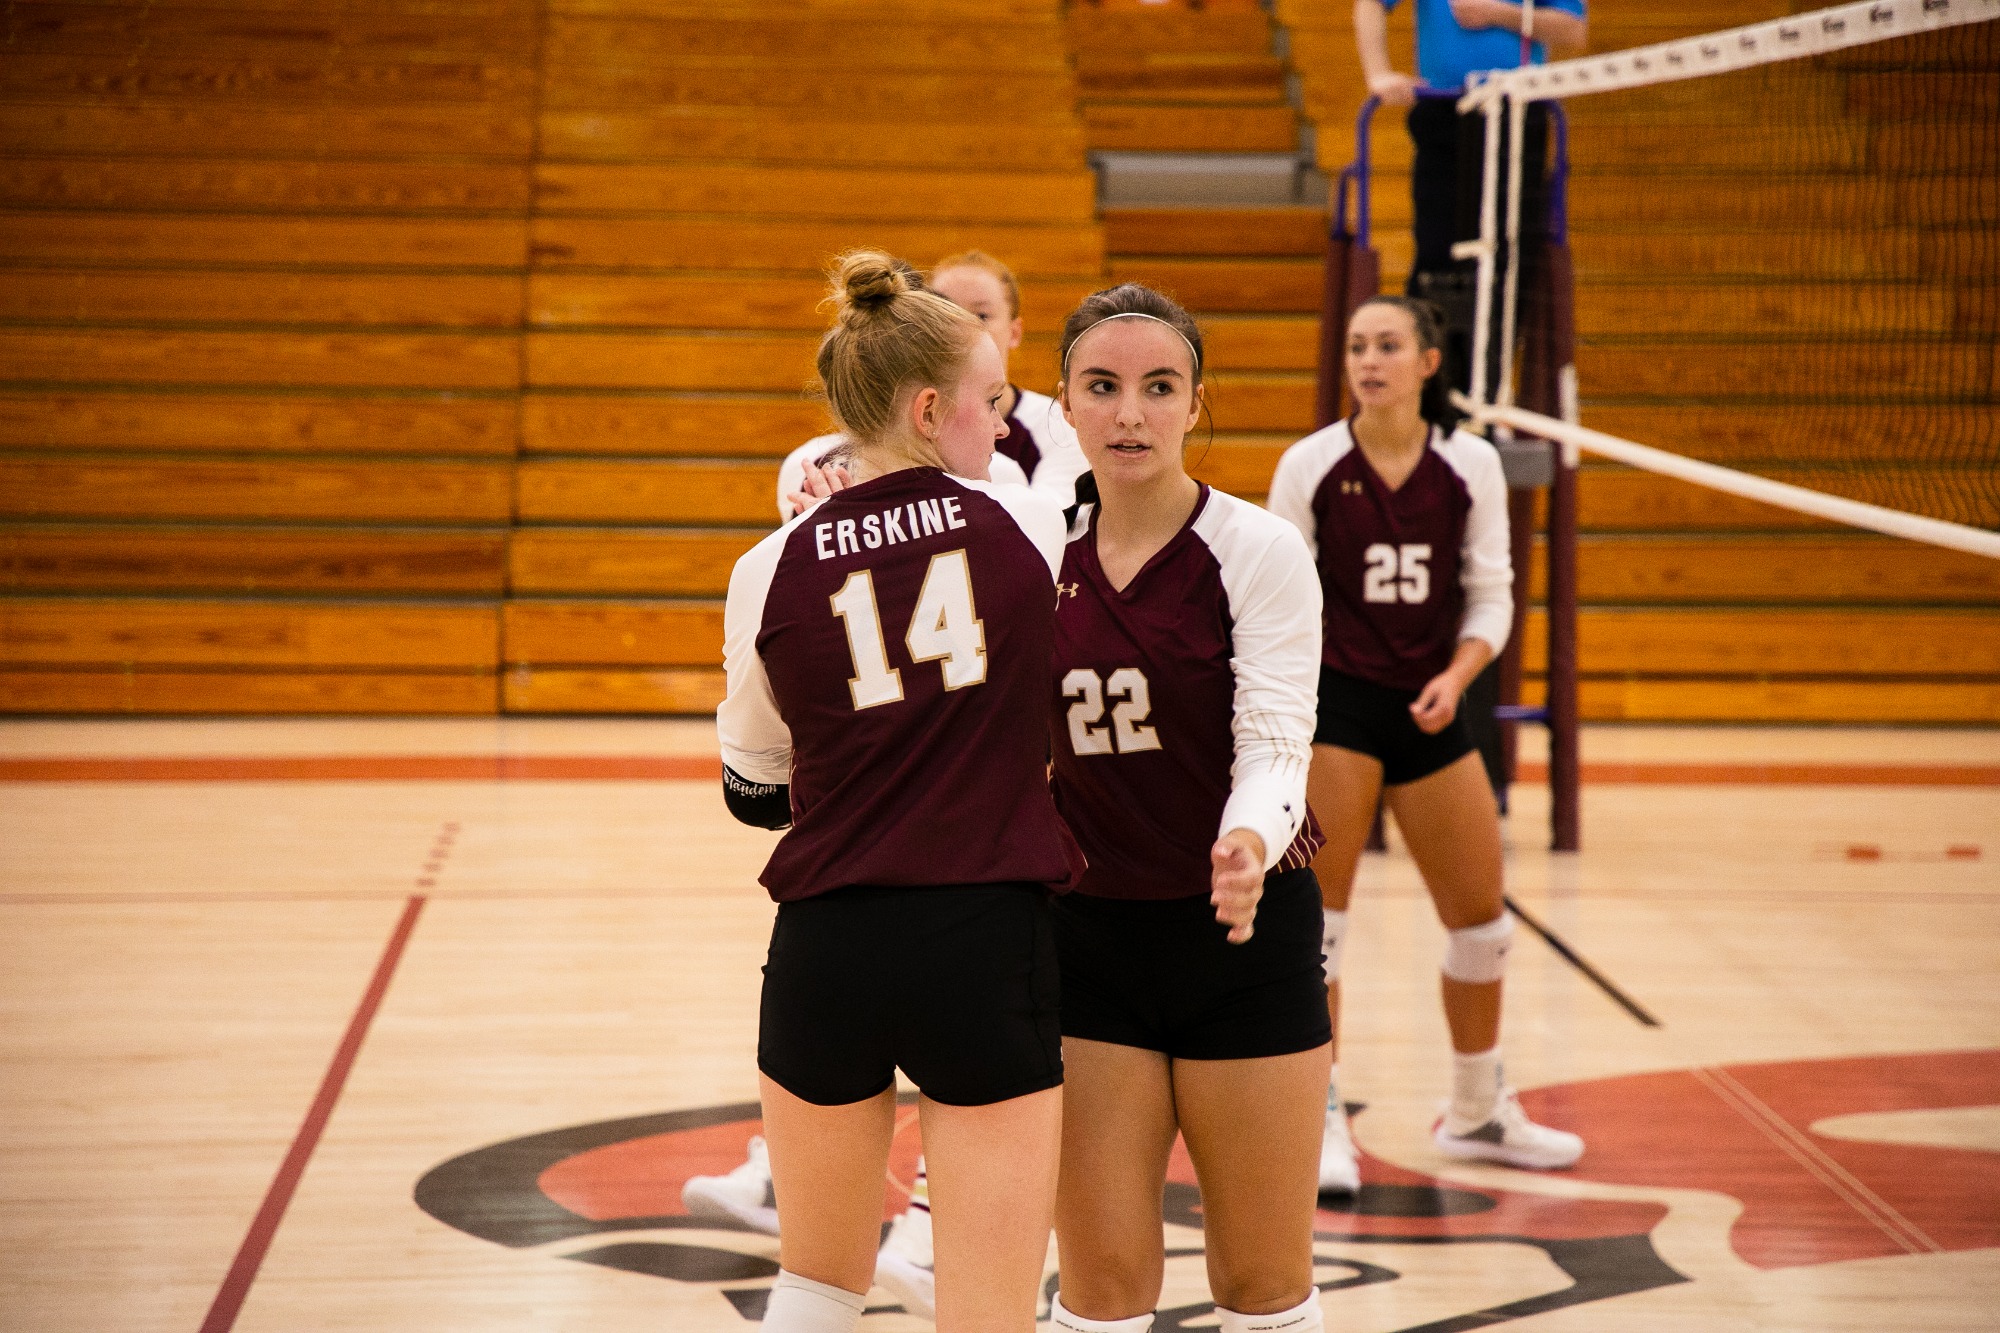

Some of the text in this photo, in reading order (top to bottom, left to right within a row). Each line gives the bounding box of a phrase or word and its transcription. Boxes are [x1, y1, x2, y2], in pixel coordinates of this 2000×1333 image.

[815, 496, 967, 561] ERSKINE
[1363, 542, 1432, 604] 25
[829, 548, 988, 711] 14
[1061, 667, 1163, 756] 22
[724, 767, 777, 797] Tandem
